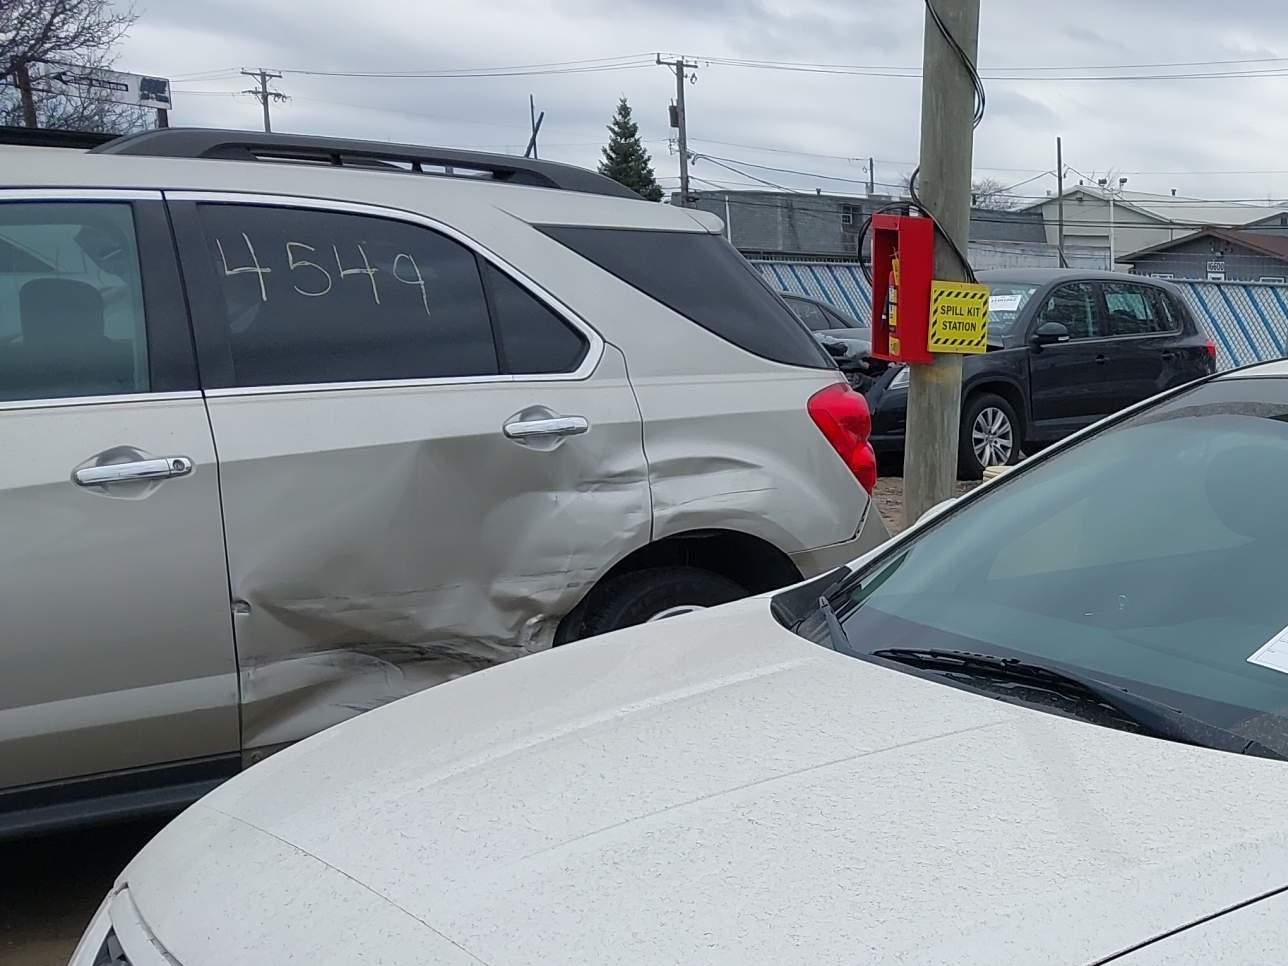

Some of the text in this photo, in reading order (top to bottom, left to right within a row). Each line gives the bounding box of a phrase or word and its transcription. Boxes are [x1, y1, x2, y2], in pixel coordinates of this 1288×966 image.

[215, 232, 431, 317] 4549
[940, 305, 980, 318] SPILL KIT
[942, 321, 977, 332] STATION
